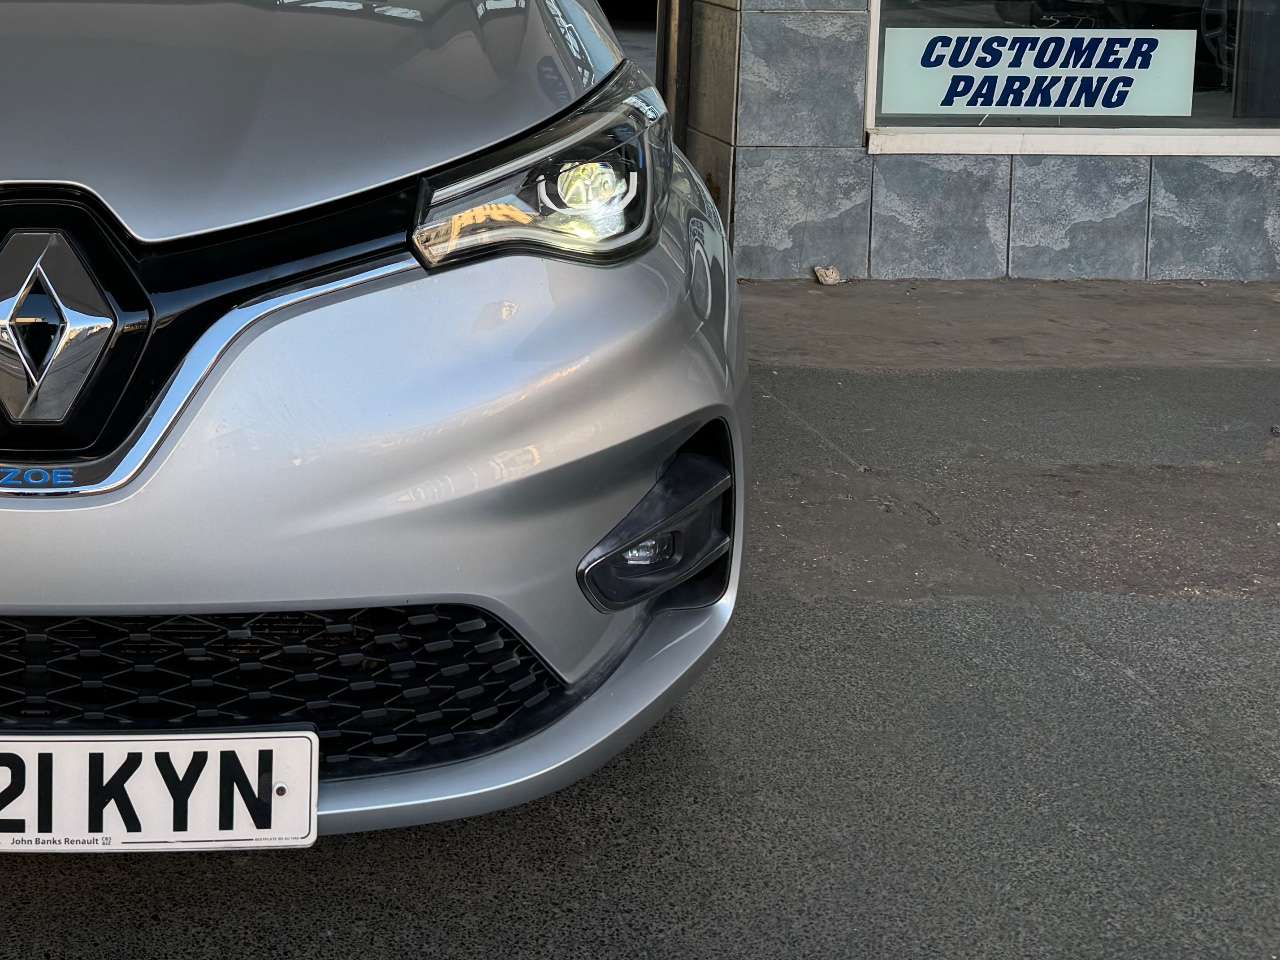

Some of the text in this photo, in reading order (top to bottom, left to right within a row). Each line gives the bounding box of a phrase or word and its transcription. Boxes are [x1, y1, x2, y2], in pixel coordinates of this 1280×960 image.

[920, 35, 1160, 70] CUSTOMER
[939, 74, 1135, 109] PARKING
[0, 467, 75, 486] ZOE
[87, 748, 274, 834] KYN
[10, 837, 33, 846] John
[35, 837, 63, 846] Banks
[64, 837, 100, 846] Renault
